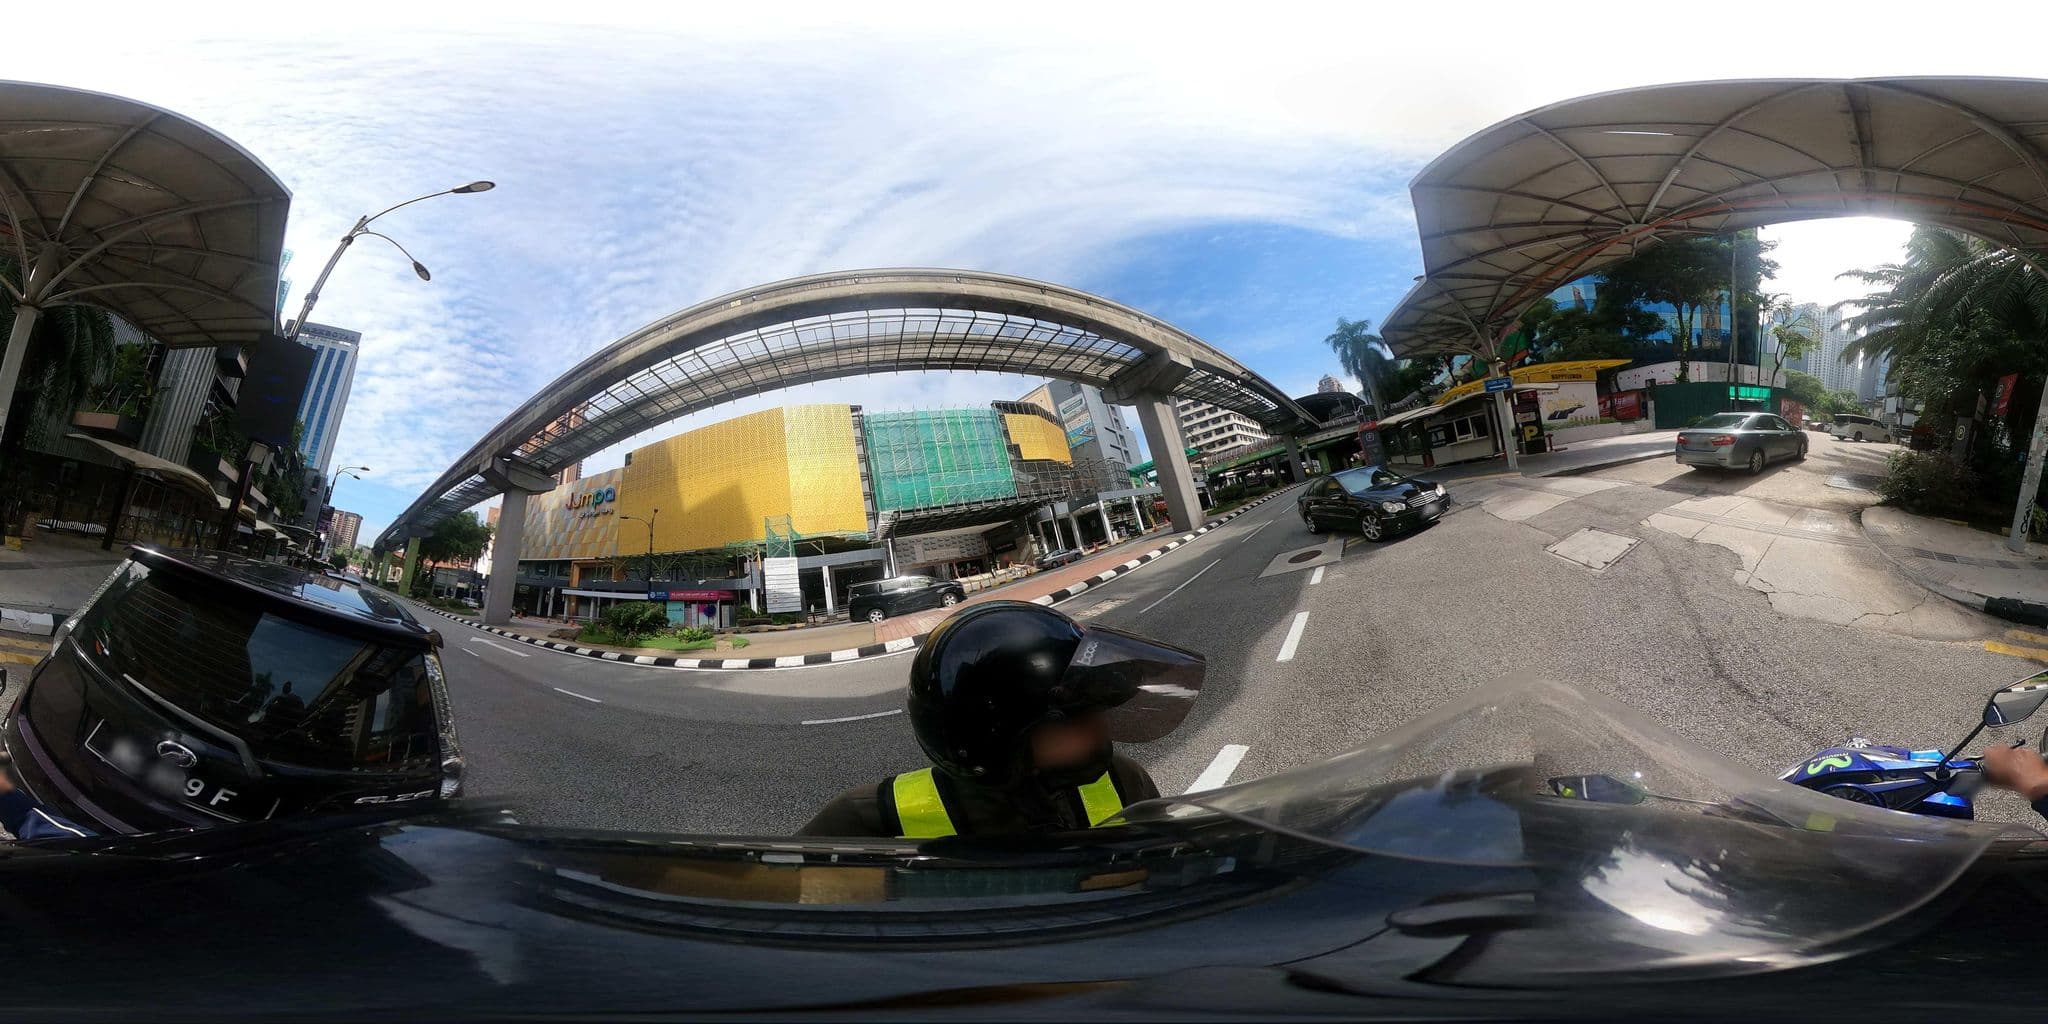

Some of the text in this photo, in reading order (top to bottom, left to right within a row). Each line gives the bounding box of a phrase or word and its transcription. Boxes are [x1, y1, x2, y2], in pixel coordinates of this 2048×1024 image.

[1523, 425, 1539, 442] P
[565, 487, 616, 511] Jumpa
[209, 788, 238, 806] F
